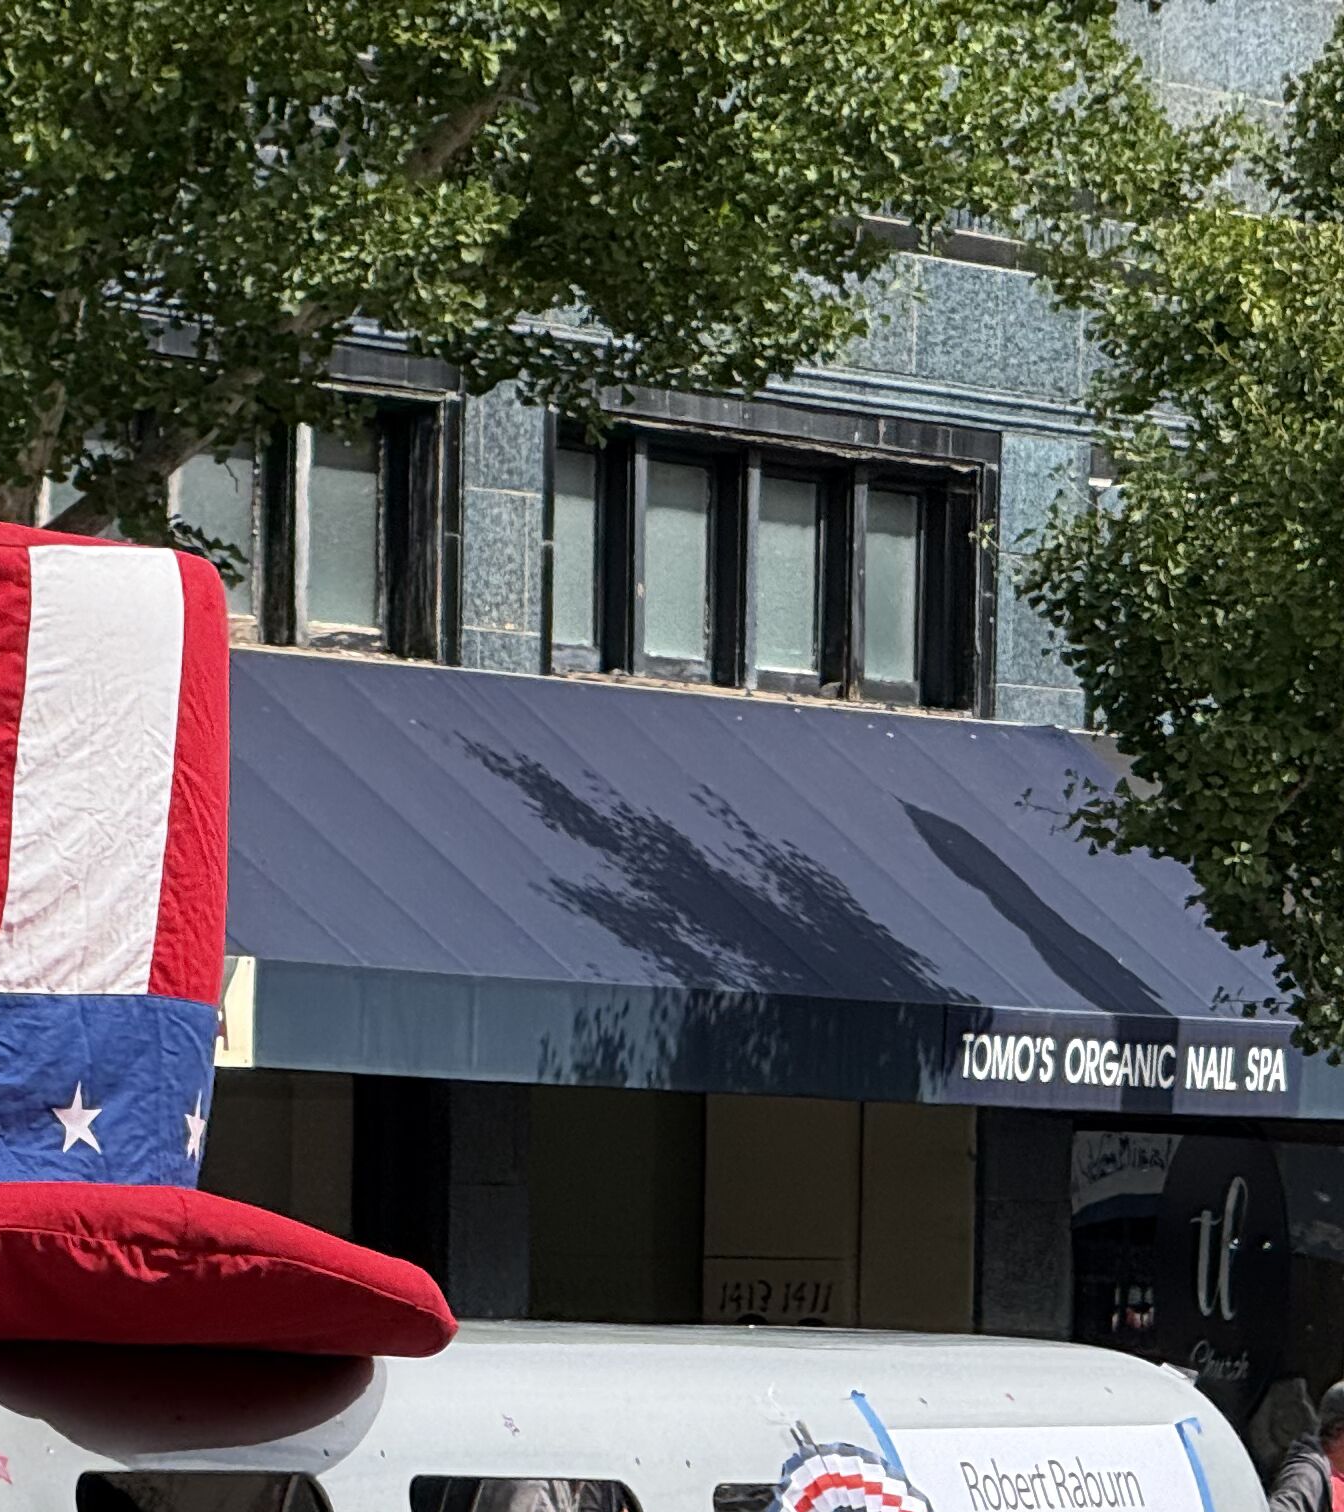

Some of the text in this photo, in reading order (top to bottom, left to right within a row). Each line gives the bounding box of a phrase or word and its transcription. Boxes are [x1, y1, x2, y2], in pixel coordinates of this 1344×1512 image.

[962, 1033, 1289, 1093] TOMO'S ORGANIC NAIL SPA
[959, 1456, 1146, 1512] Robert Raburn
